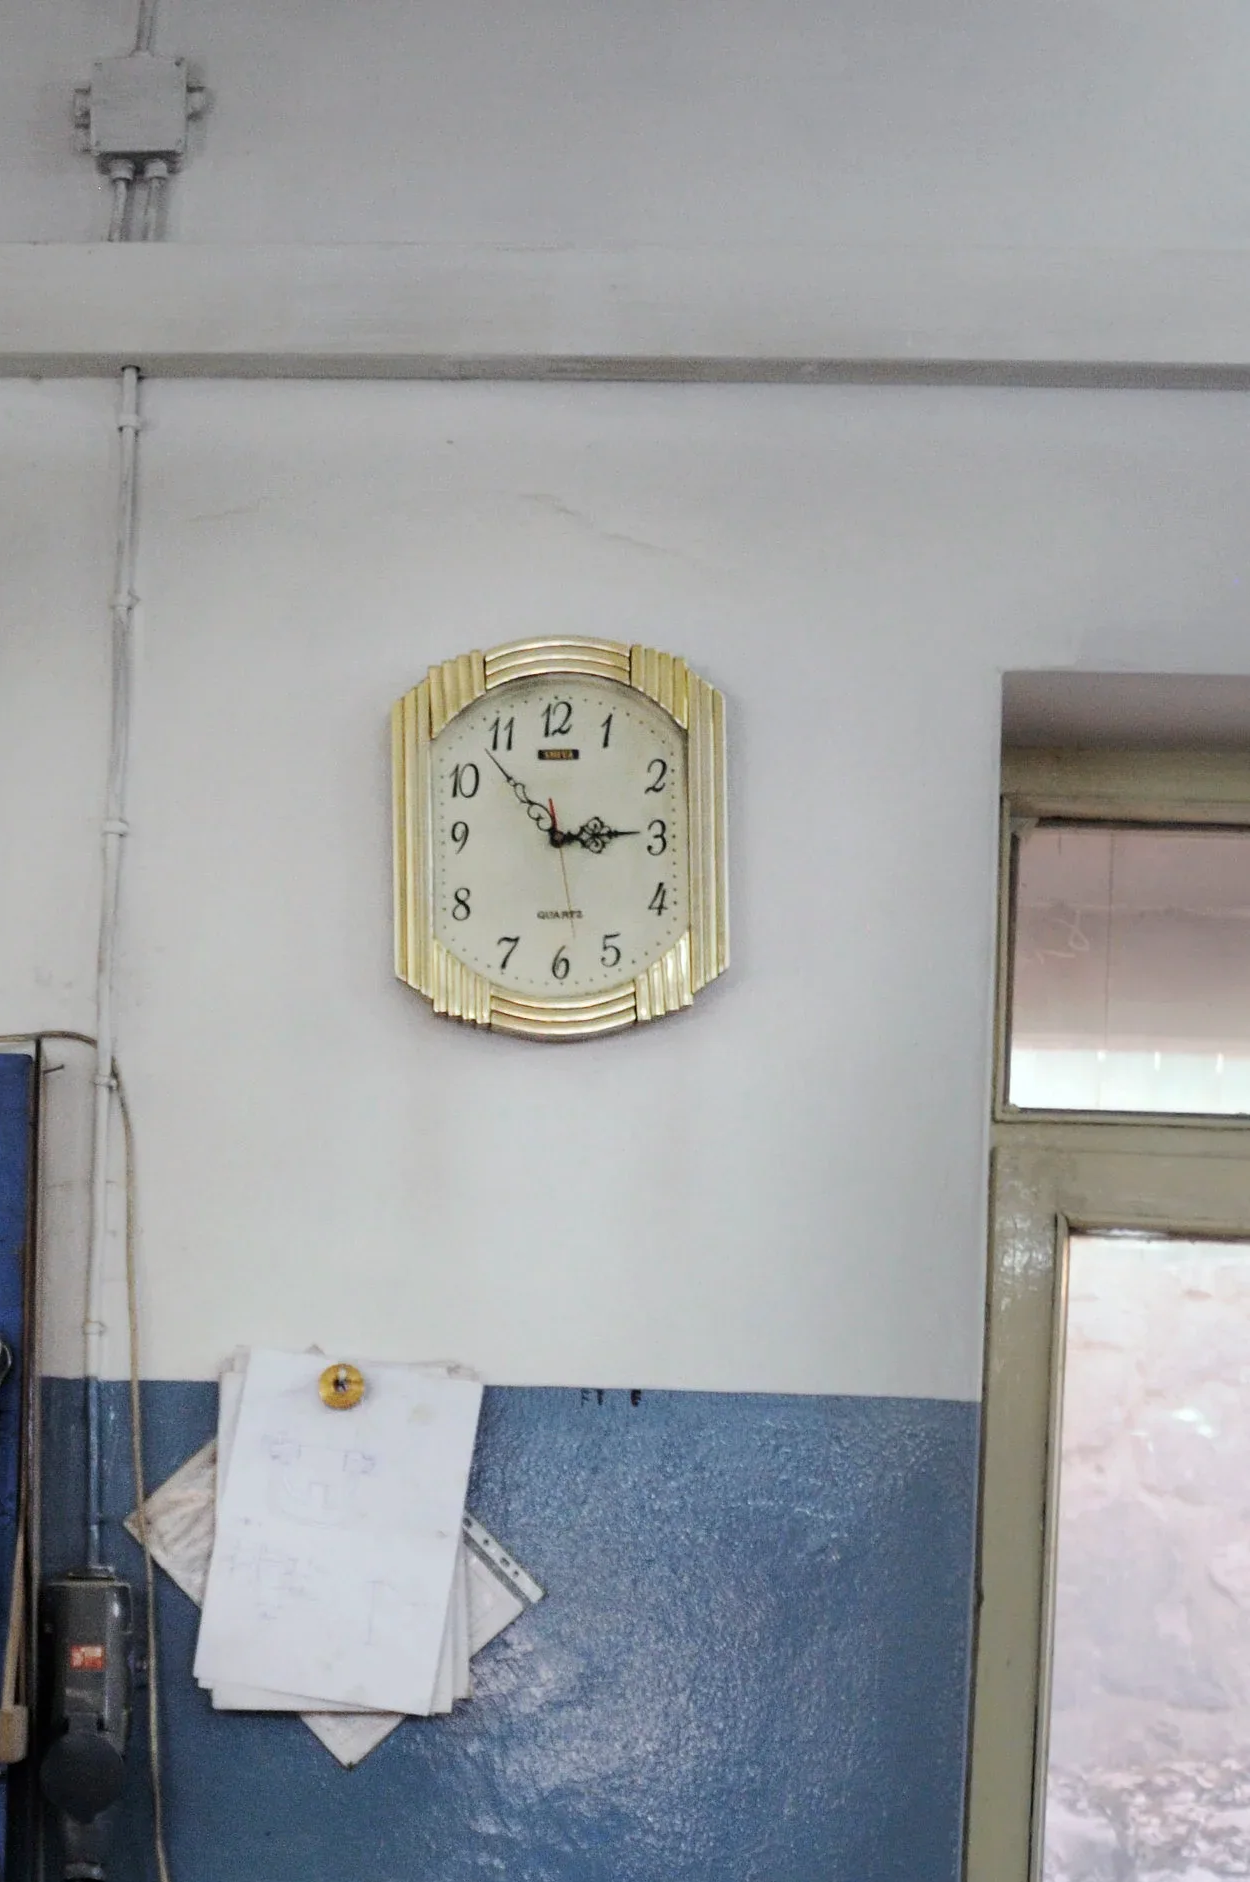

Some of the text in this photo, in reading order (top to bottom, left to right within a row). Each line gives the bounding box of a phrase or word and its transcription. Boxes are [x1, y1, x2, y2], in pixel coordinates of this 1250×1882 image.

[489, 716, 515, 751] 11
[541, 701, 573, 738] 12
[600, 713, 613, 749] 1
[450, 763, 480, 799] 10
[644, 759, 668, 795] 2
[451, 821, 470, 855] 9
[646, 819, 668, 856] 3
[452, 887, 472, 922] 8
[537, 910, 584, 920] QUARTZ
[648, 882, 669, 917] 4
[497, 936, 520, 971] 7
[550, 946, 570, 980] 6
[600, 932, 622, 968] 5
